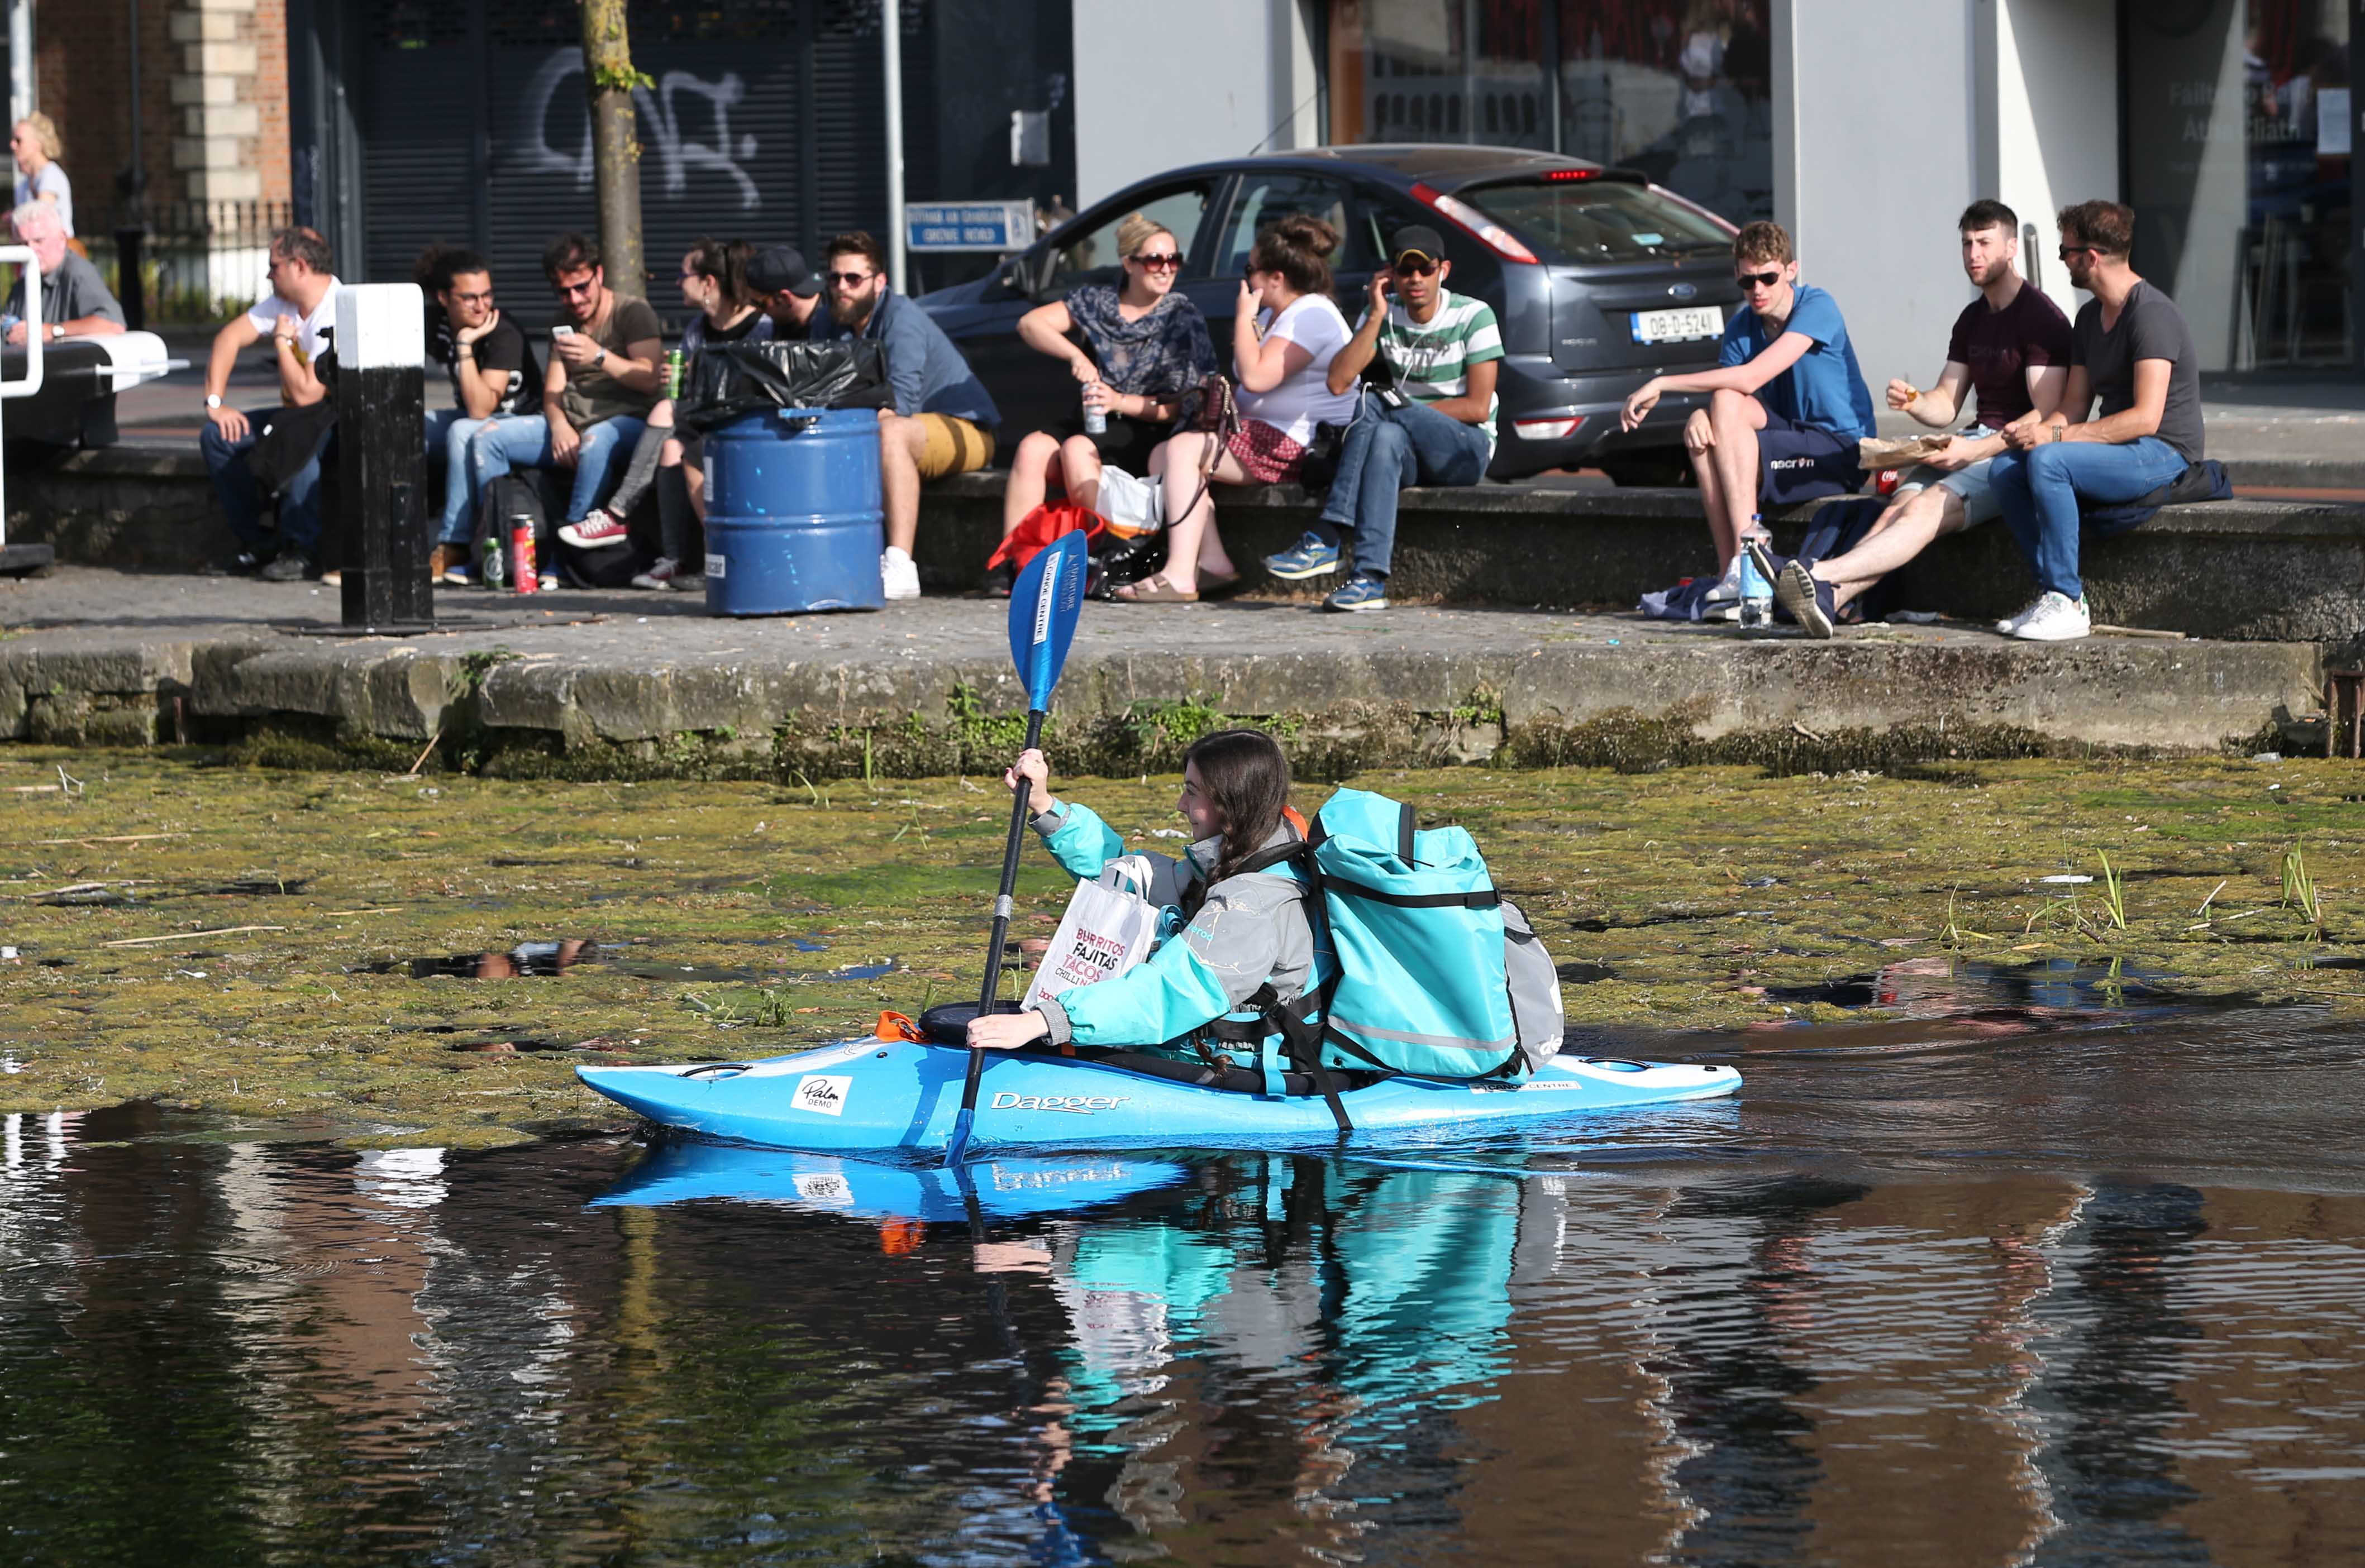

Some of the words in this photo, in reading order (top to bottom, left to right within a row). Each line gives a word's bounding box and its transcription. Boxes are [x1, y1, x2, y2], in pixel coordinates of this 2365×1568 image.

[963, 227, 996, 242] ROAD
[1043, 566, 1053, 595] CANOE
[1037, 598, 1047, 636] CENTRE
[1076, 928, 1126, 956] BURRITOS
[1062, 954, 1103, 982] TACOS
[1072, 941, 1118, 971] FAJITAS
[1055, 967, 1080, 985] CHILLI
[802, 1079, 838, 1101] Palm
[808, 1098, 832, 1108] DEMO
[990, 1091, 1131, 1115] Dagger
